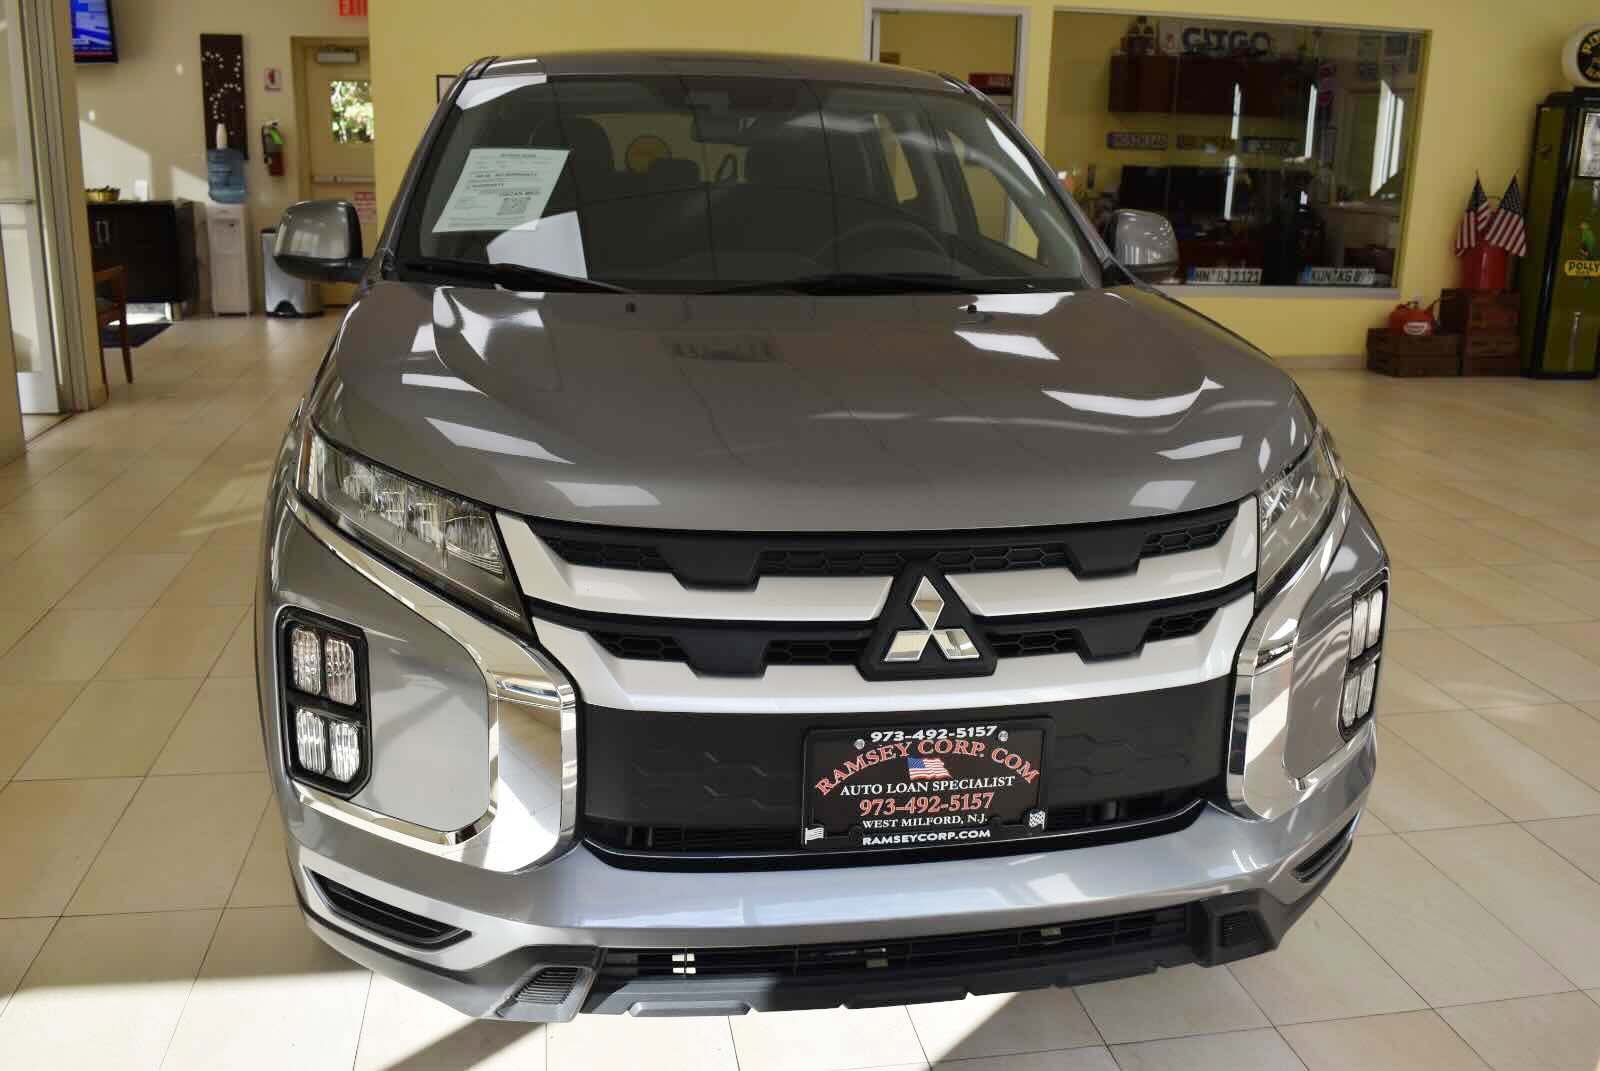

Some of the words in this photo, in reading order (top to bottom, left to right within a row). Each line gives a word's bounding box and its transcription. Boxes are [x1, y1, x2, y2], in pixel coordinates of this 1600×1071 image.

[1182, 27, 1272, 54] CITGO
[1568, 256, 1600, 272] POLLY
[870, 725, 998, 743] 973-492-5157
[815, 739, 913, 796] RAMSEY
[991, 747, 1040, 784] COM
[840, 784, 884, 796] AUTO
[886, 781, 929, 794] LOAN
[932, 776, 1015, 792] SPECIALIST
[859, 792, 995, 817] 973-492-5157
[862, 818, 898, 829] WEST
[901, 815, 965, 828] MILFORD,
[967, 814, 989, 825] N.J.
[862, 829, 991, 846] RAMSEYCORP.COM
